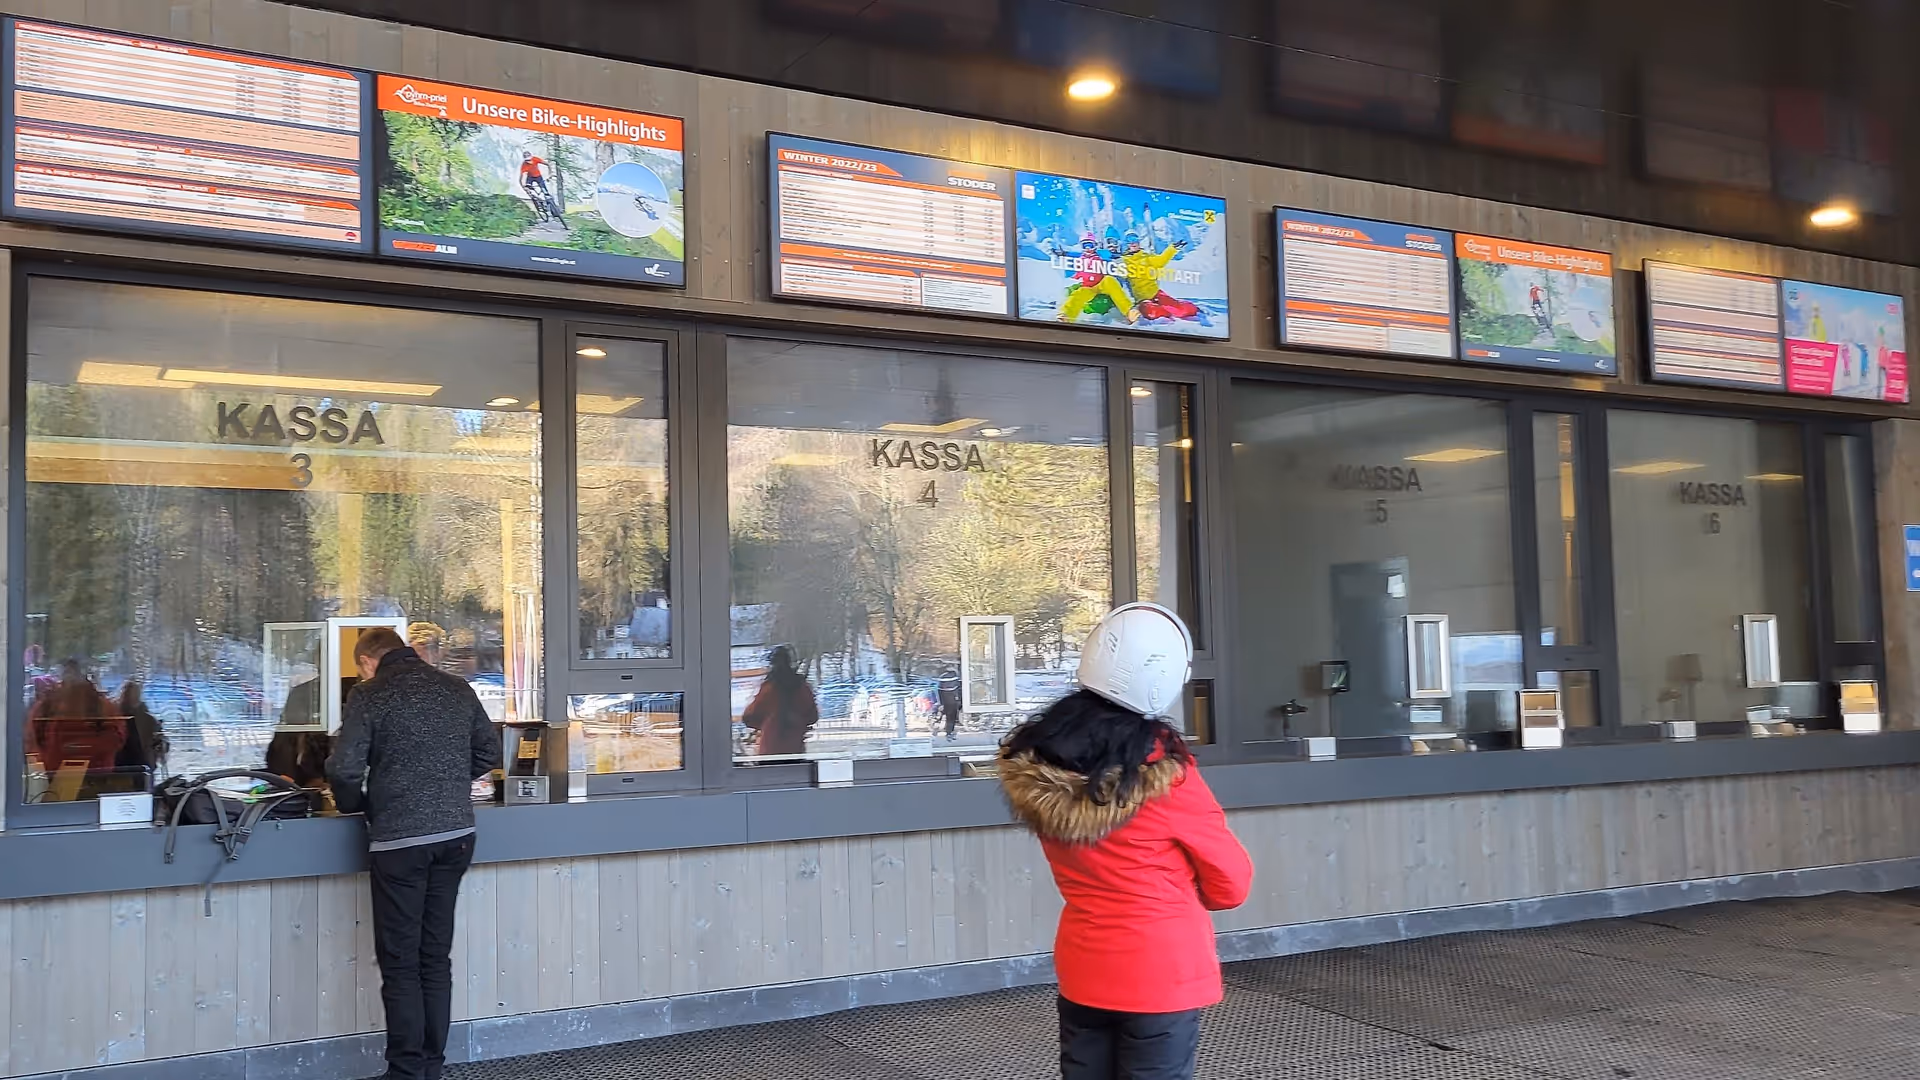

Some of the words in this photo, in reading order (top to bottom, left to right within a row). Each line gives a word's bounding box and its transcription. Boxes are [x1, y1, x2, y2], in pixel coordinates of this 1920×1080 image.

[462, 96, 527, 121] Unsere
[531, 107, 667, 142] Bike-Highlights
[783, 151, 829, 165] WINTER
[831, 158, 878, 172] 2022/23
[947, 176, 997, 191] STODER
[1050, 253, 1201, 285] LIEBLINGSSPORTART
[1497, 245, 1532, 261] Unsere
[1532, 250, 1604, 272] Bike-Highlights
[217, 401, 386, 445] KASSA
[872, 438, 986, 472] KASSA
[290, 452, 313, 488] 3
[916, 479, 940, 508] 4
[1680, 481, 1747, 506] KASSA
[1376, 499, 1388, 523] 5
[1709, 512, 1721, 534] 6
